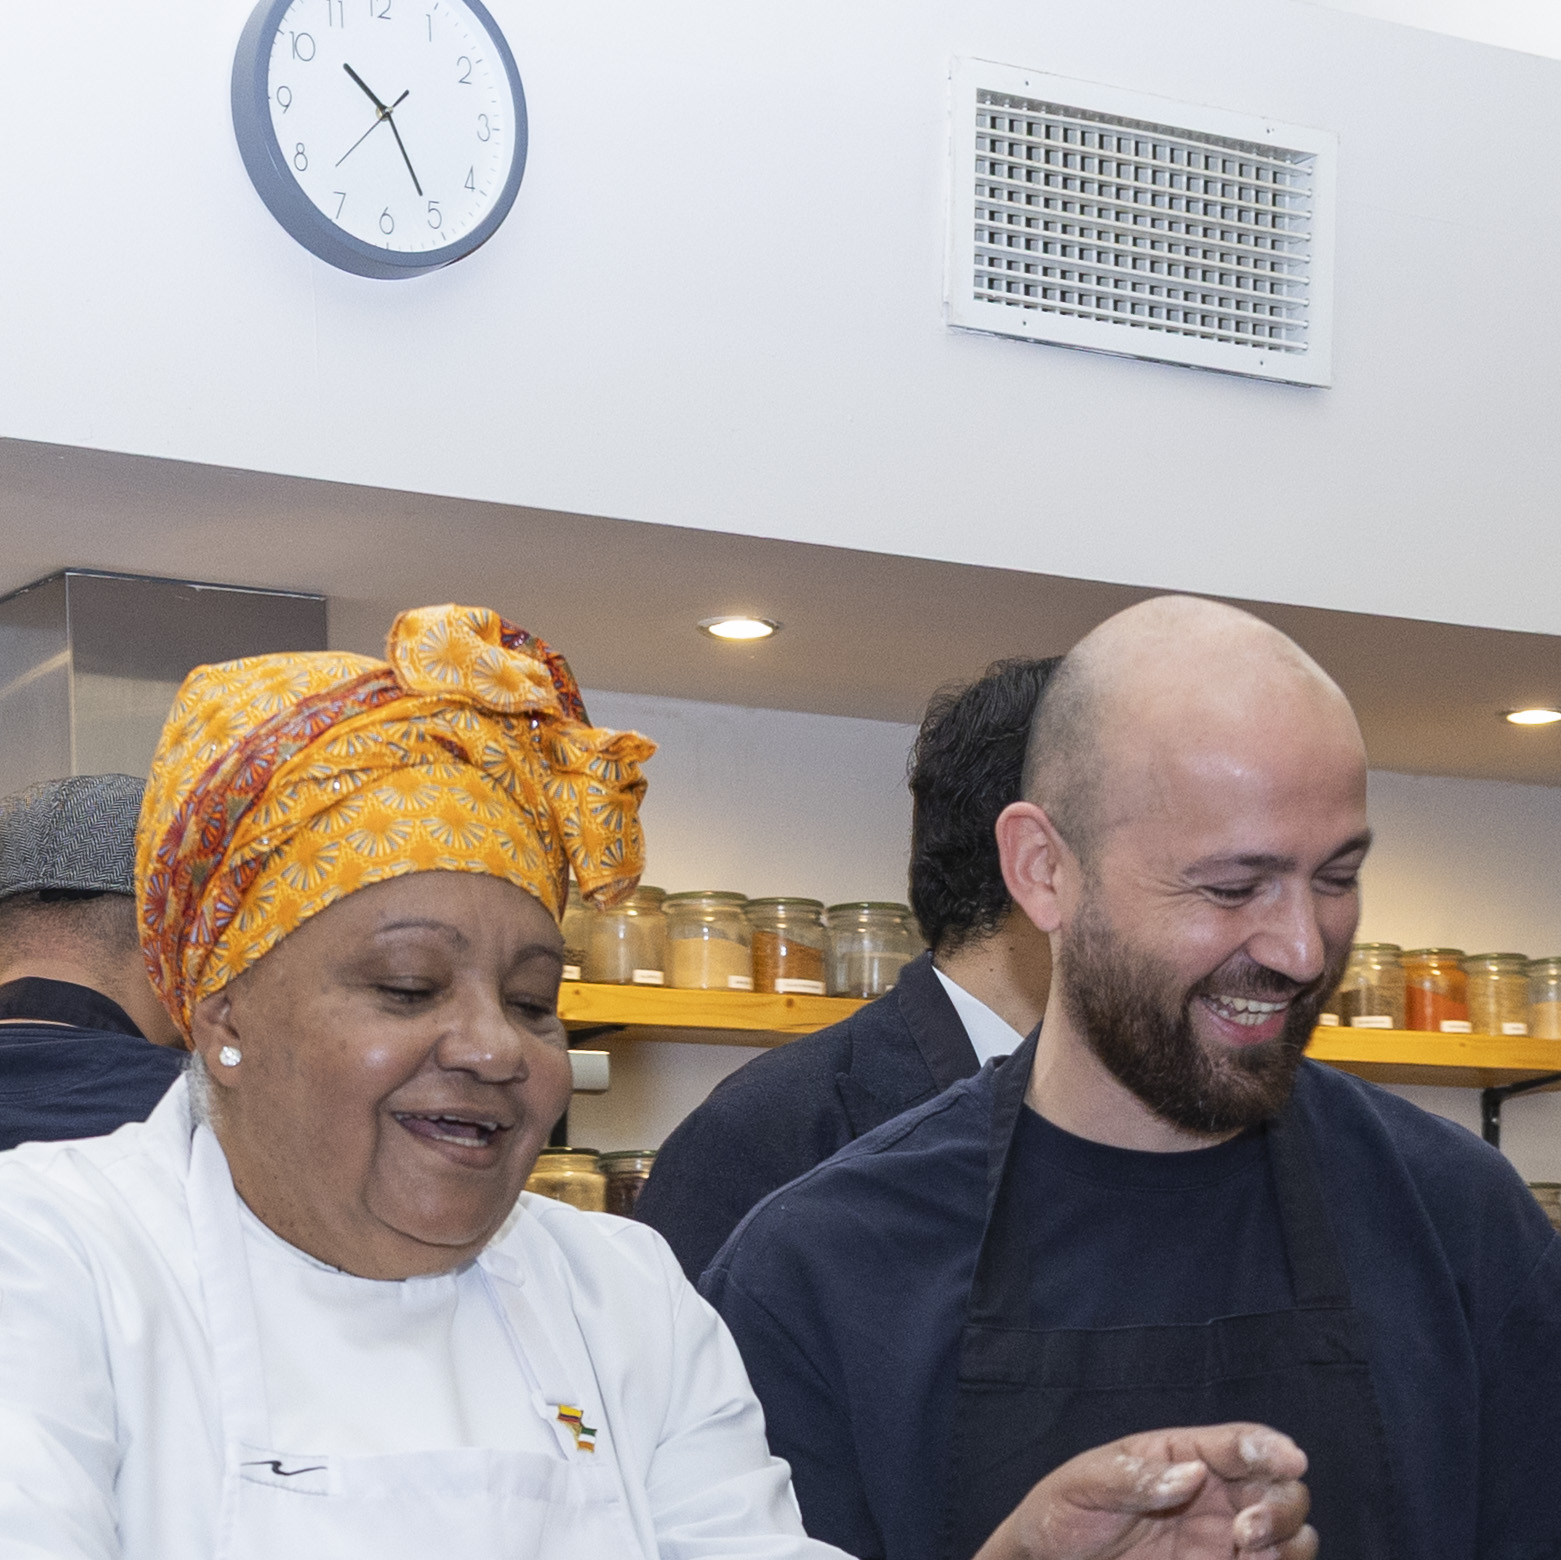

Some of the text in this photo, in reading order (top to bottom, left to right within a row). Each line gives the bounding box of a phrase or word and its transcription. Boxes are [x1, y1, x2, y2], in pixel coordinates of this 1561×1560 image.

[425, 13, 432, 42] 1
[289, 31, 316, 62] 10
[456, 55, 472, 85] 2
[276, 85, 293, 114] 9
[476, 113, 491, 142] 3
[293, 142, 309, 172] 8
[463, 165, 476, 192] 4
[333, 191, 347, 220] 7
[427, 200, 443, 230] 5
[378, 206, 395, 235] 6
